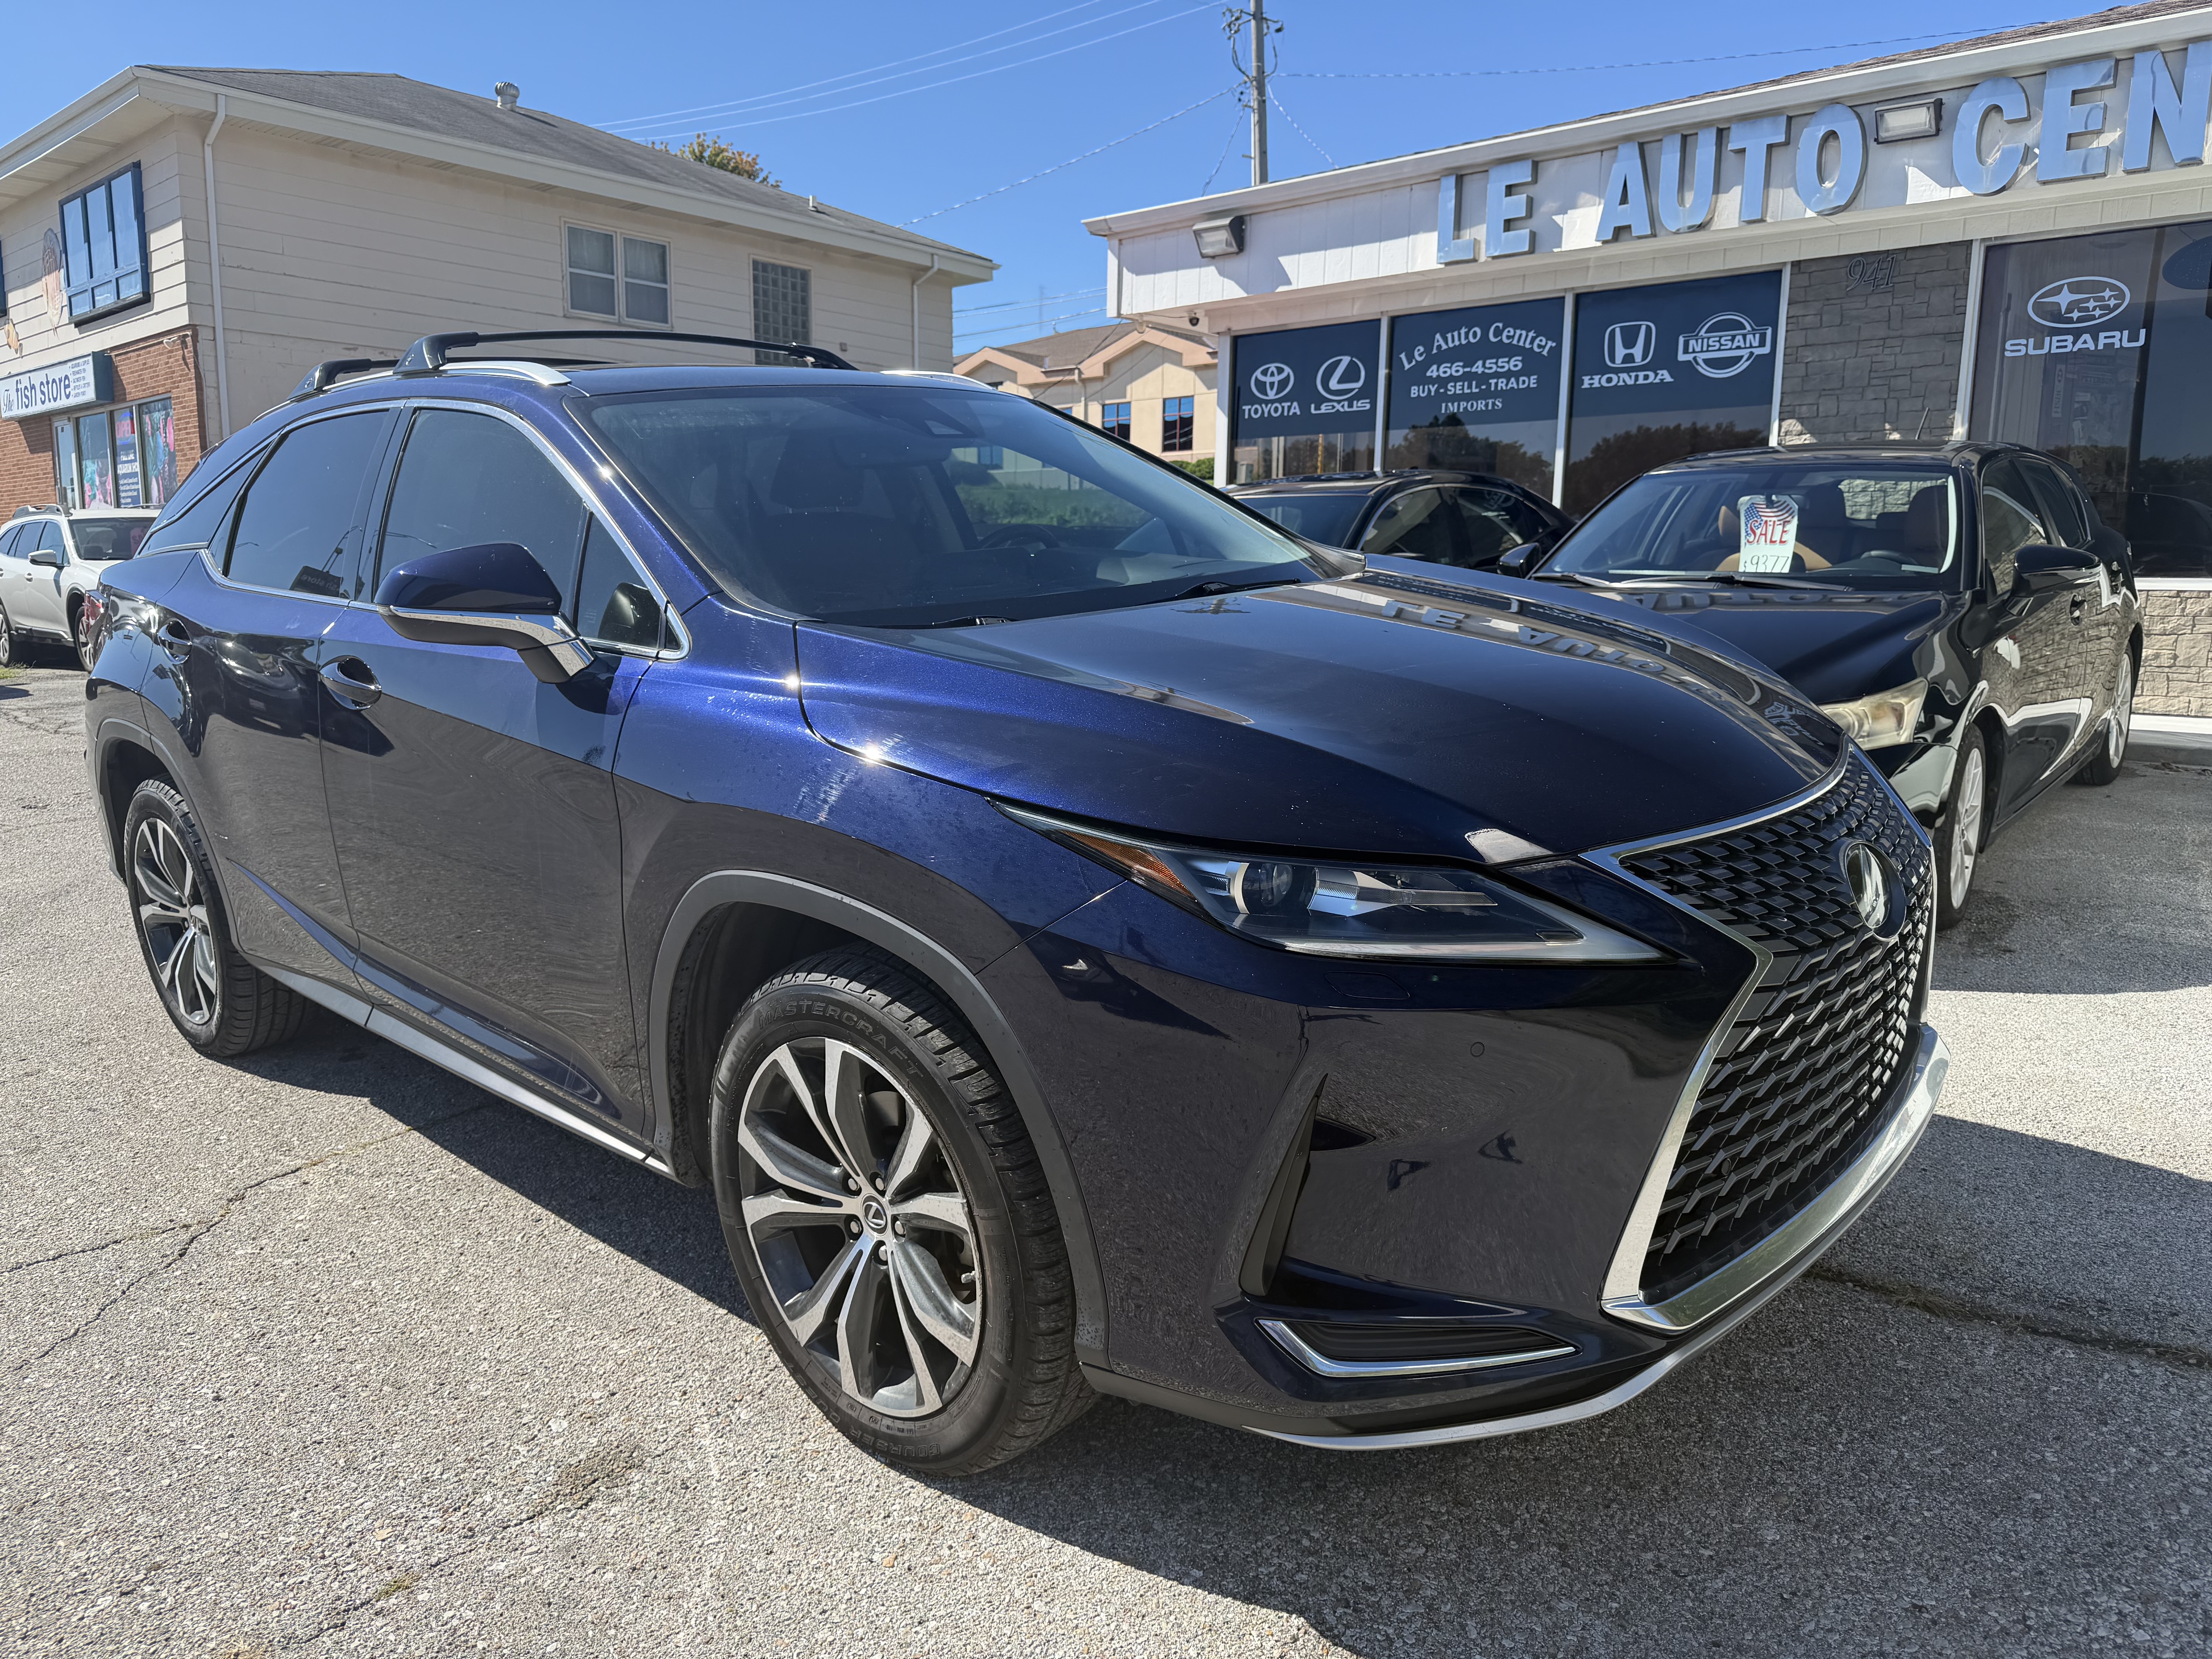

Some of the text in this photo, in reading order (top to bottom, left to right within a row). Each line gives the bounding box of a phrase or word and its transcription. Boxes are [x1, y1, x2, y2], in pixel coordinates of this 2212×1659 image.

[1436, 160, 1536, 264] LE
[1595, 102, 1868, 243] AUTO
[1846, 254, 1896, 291] 941
[1399, 322, 1556, 371] Le Auto Center
[1688, 333, 1760, 352] NISSAN
[2004, 329, 2146, 357] SUBARU
[1426, 356, 1523, 378] 466-4556
[1582, 369, 1674, 388] HONDA
[3, 373, 71, 413] The fish store
[1311, 399, 1370, 414] LEXUS
[1441, 398, 1502, 413] IMPORTS
[1242, 401, 1300, 419] TOYOTA
[1747, 519, 1793, 545] SALE
[759, 999, 924, 1077] MASTERCRAFT
[851, 1425, 941, 1458] COURSER
